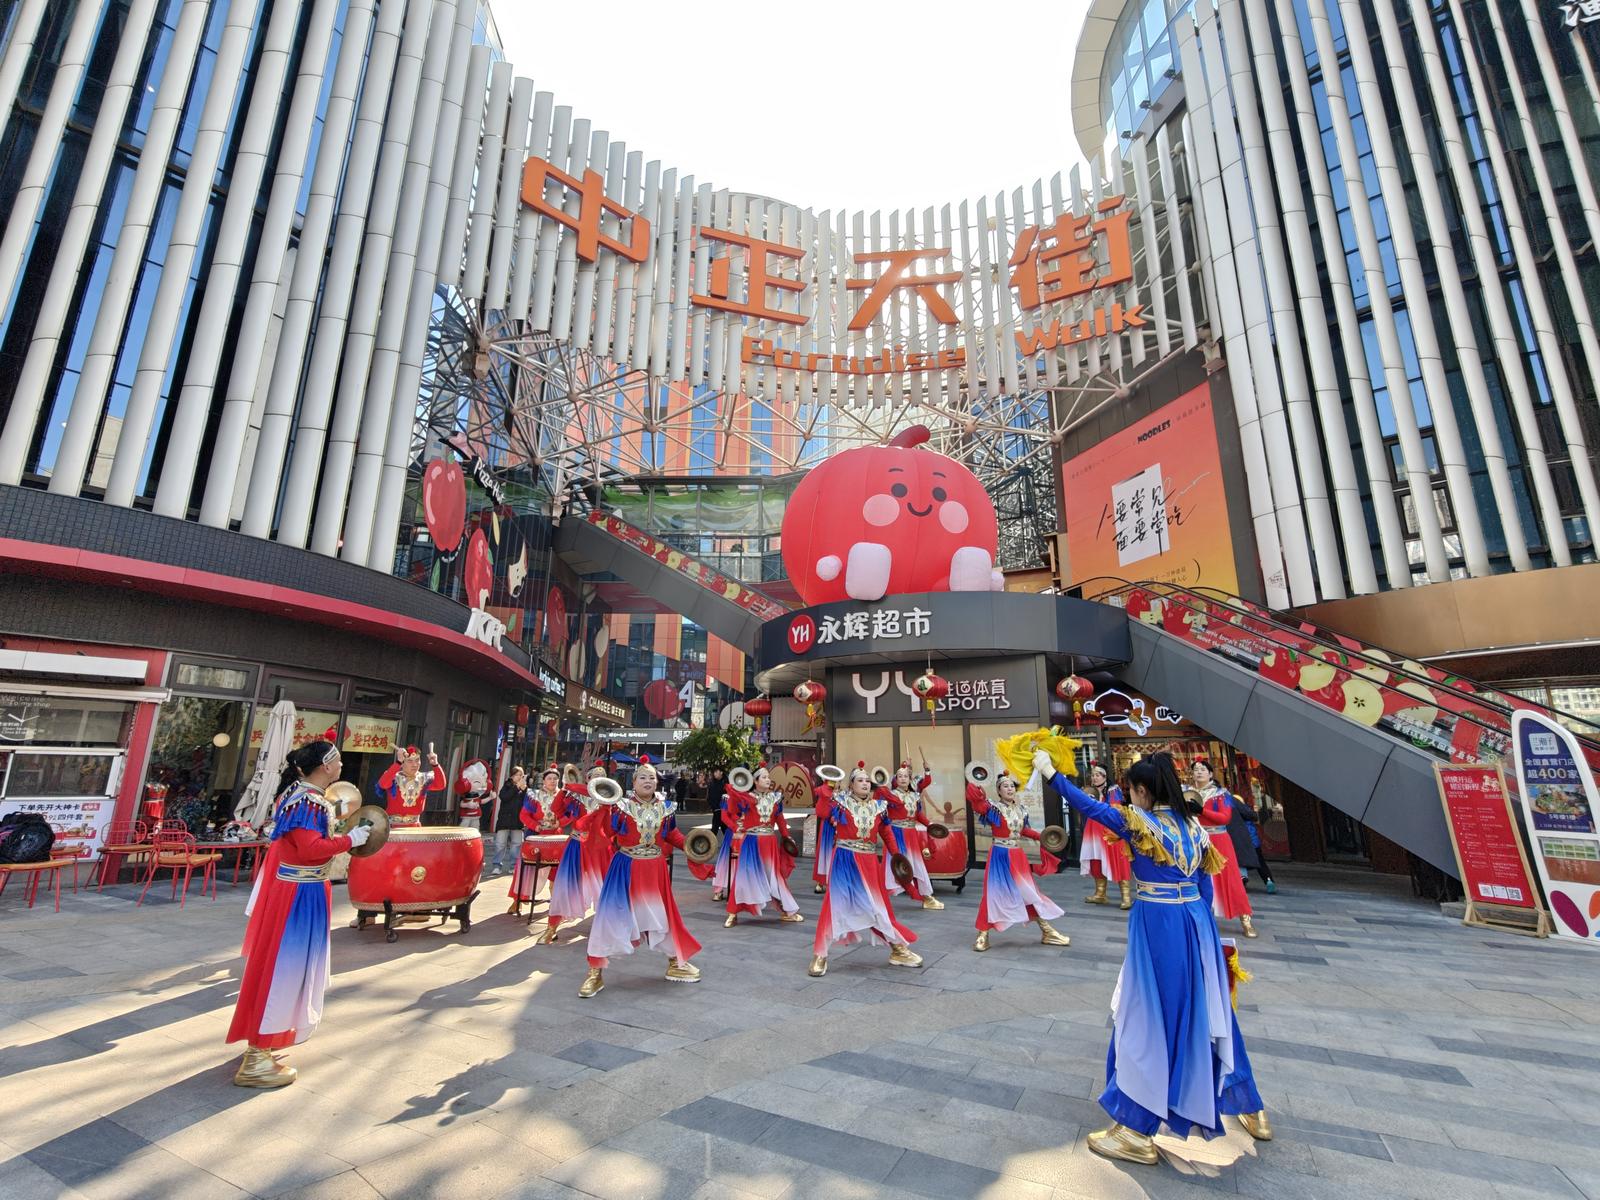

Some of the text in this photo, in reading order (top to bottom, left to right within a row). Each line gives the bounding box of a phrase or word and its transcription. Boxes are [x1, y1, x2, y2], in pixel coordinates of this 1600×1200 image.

[522, 156, 1135, 331] 中正天街
[742, 303, 1147, 374] Paradise Walk
[1137, 420, 1171, 443] NOODLES
[474, 456, 493, 489] Pizza
[464, 608, 507, 653] KFC
[792, 624, 811, 645] YH
[817, 606, 932, 645] 永辉超市
[589, 696, 611, 714] CHAGEE
[679, 680, 695, 708] 4
[1527, 768, 1579, 779] 超400家
